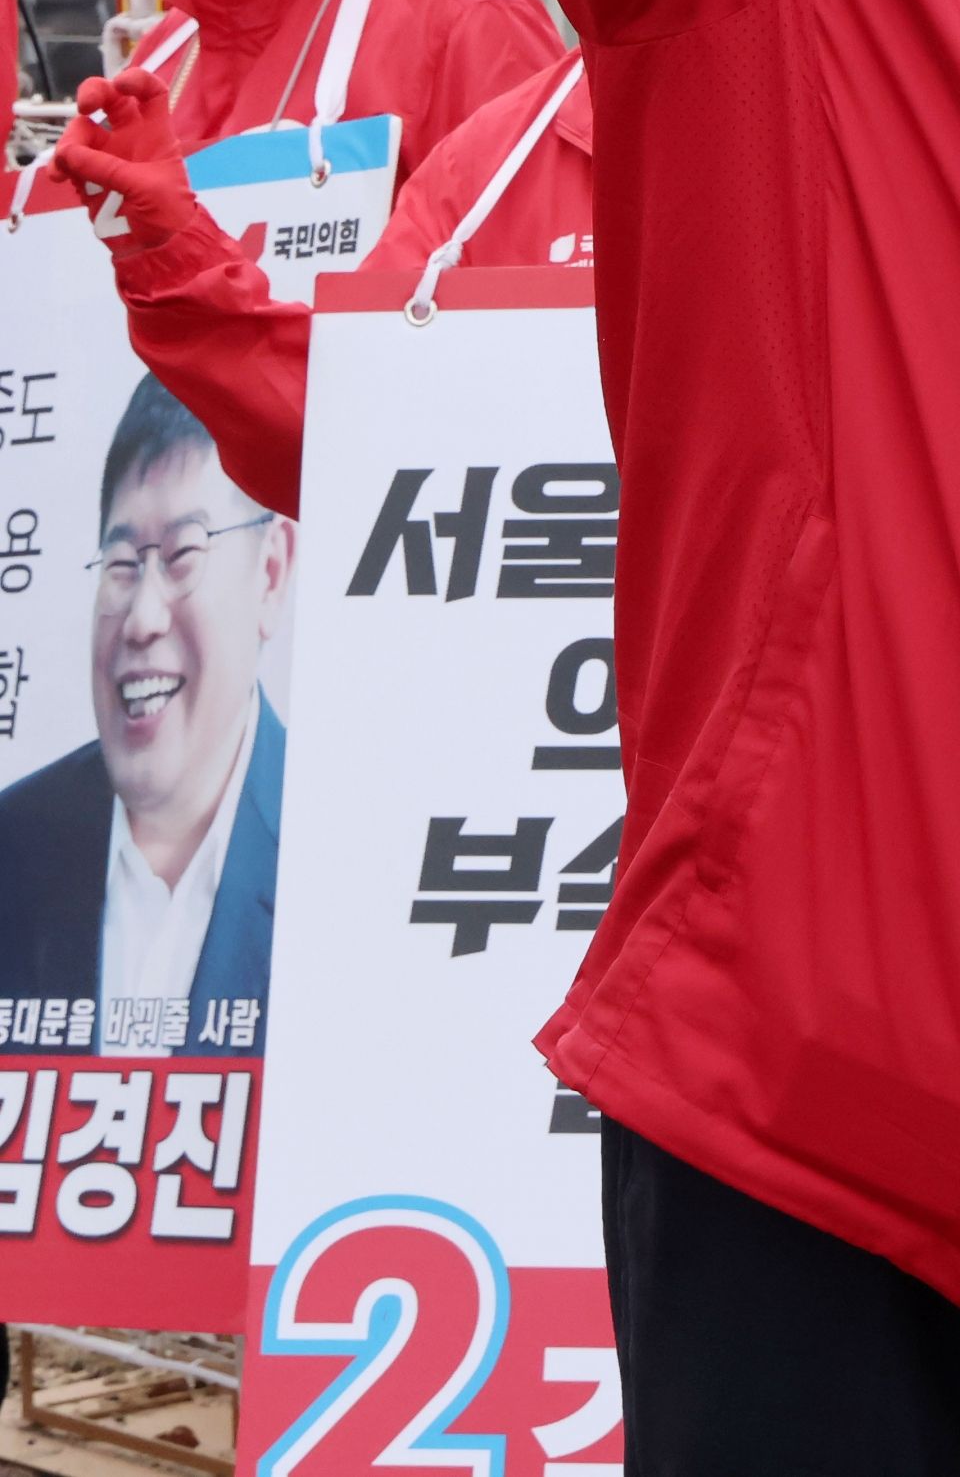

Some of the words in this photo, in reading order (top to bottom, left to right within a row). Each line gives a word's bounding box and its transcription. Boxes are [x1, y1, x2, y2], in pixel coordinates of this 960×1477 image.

[274, 218, 360, 260] 국민의힘
[105, 998, 190, 1047] 바꿔줄
[199, 998, 260, 1047] 사람
[257, 1194, 511, 1477] 2
